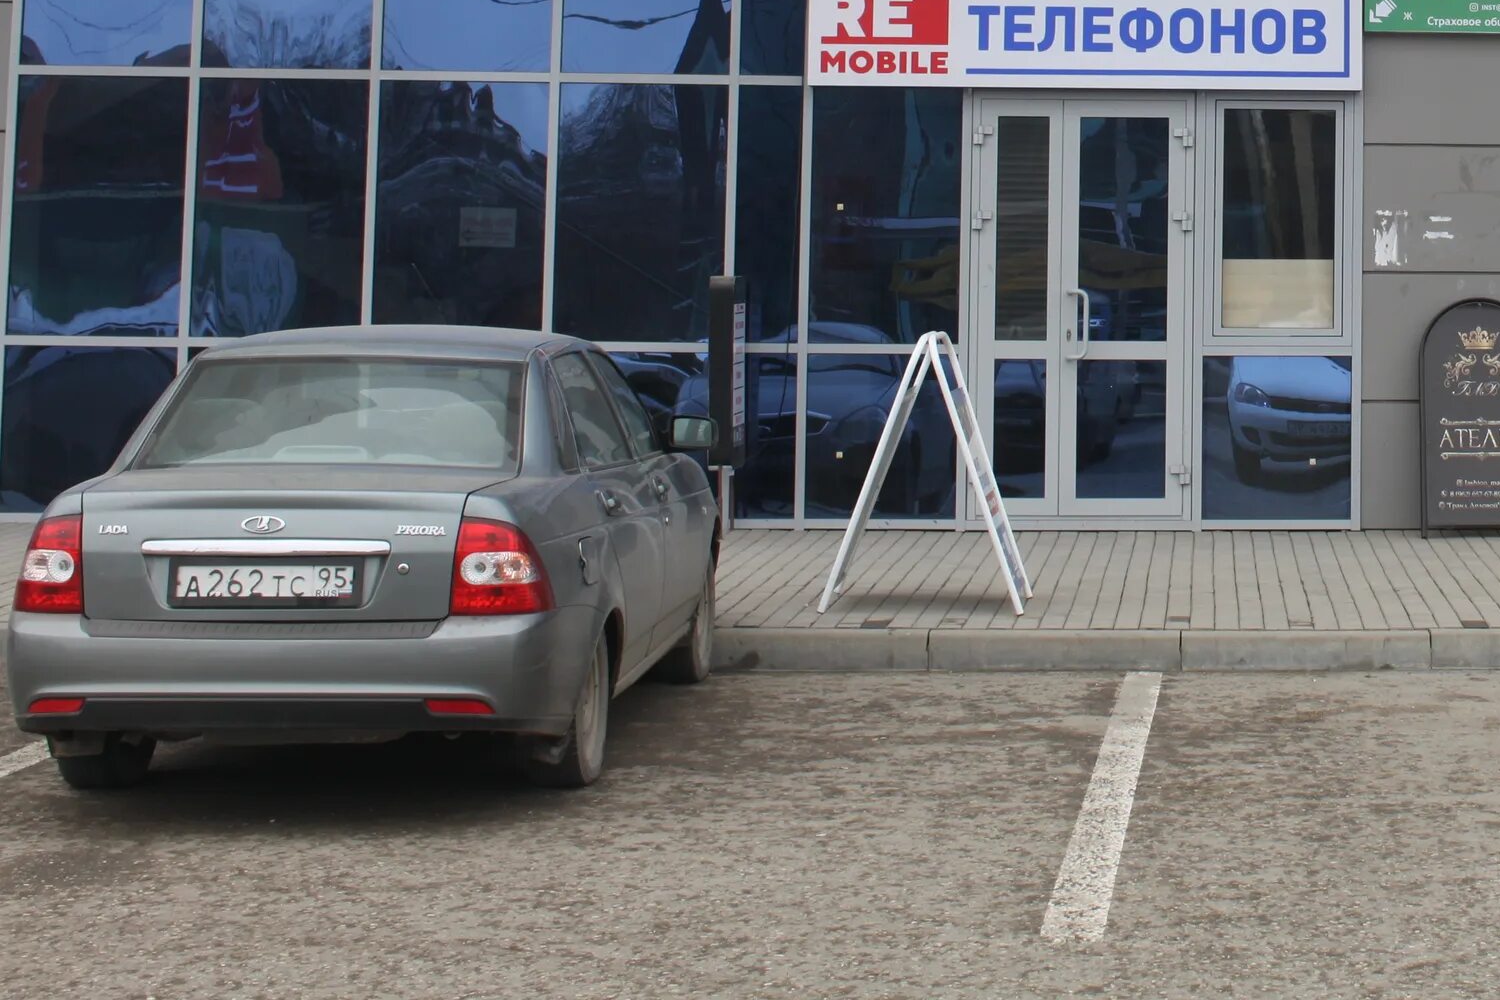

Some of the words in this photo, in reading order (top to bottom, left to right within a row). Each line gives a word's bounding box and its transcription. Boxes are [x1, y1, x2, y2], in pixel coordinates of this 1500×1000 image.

[1427, 16, 1482, 28] Страховое
[967, 5, 1327, 55] ТЕЛЕФОНОВ
[820, 51, 949, 75] MOBILE
[99, 524, 129, 535] LADA
[395, 525, 447, 536] PRIORA
[318, 567, 347, 588] 95
[315, 589, 338, 598] RUS
